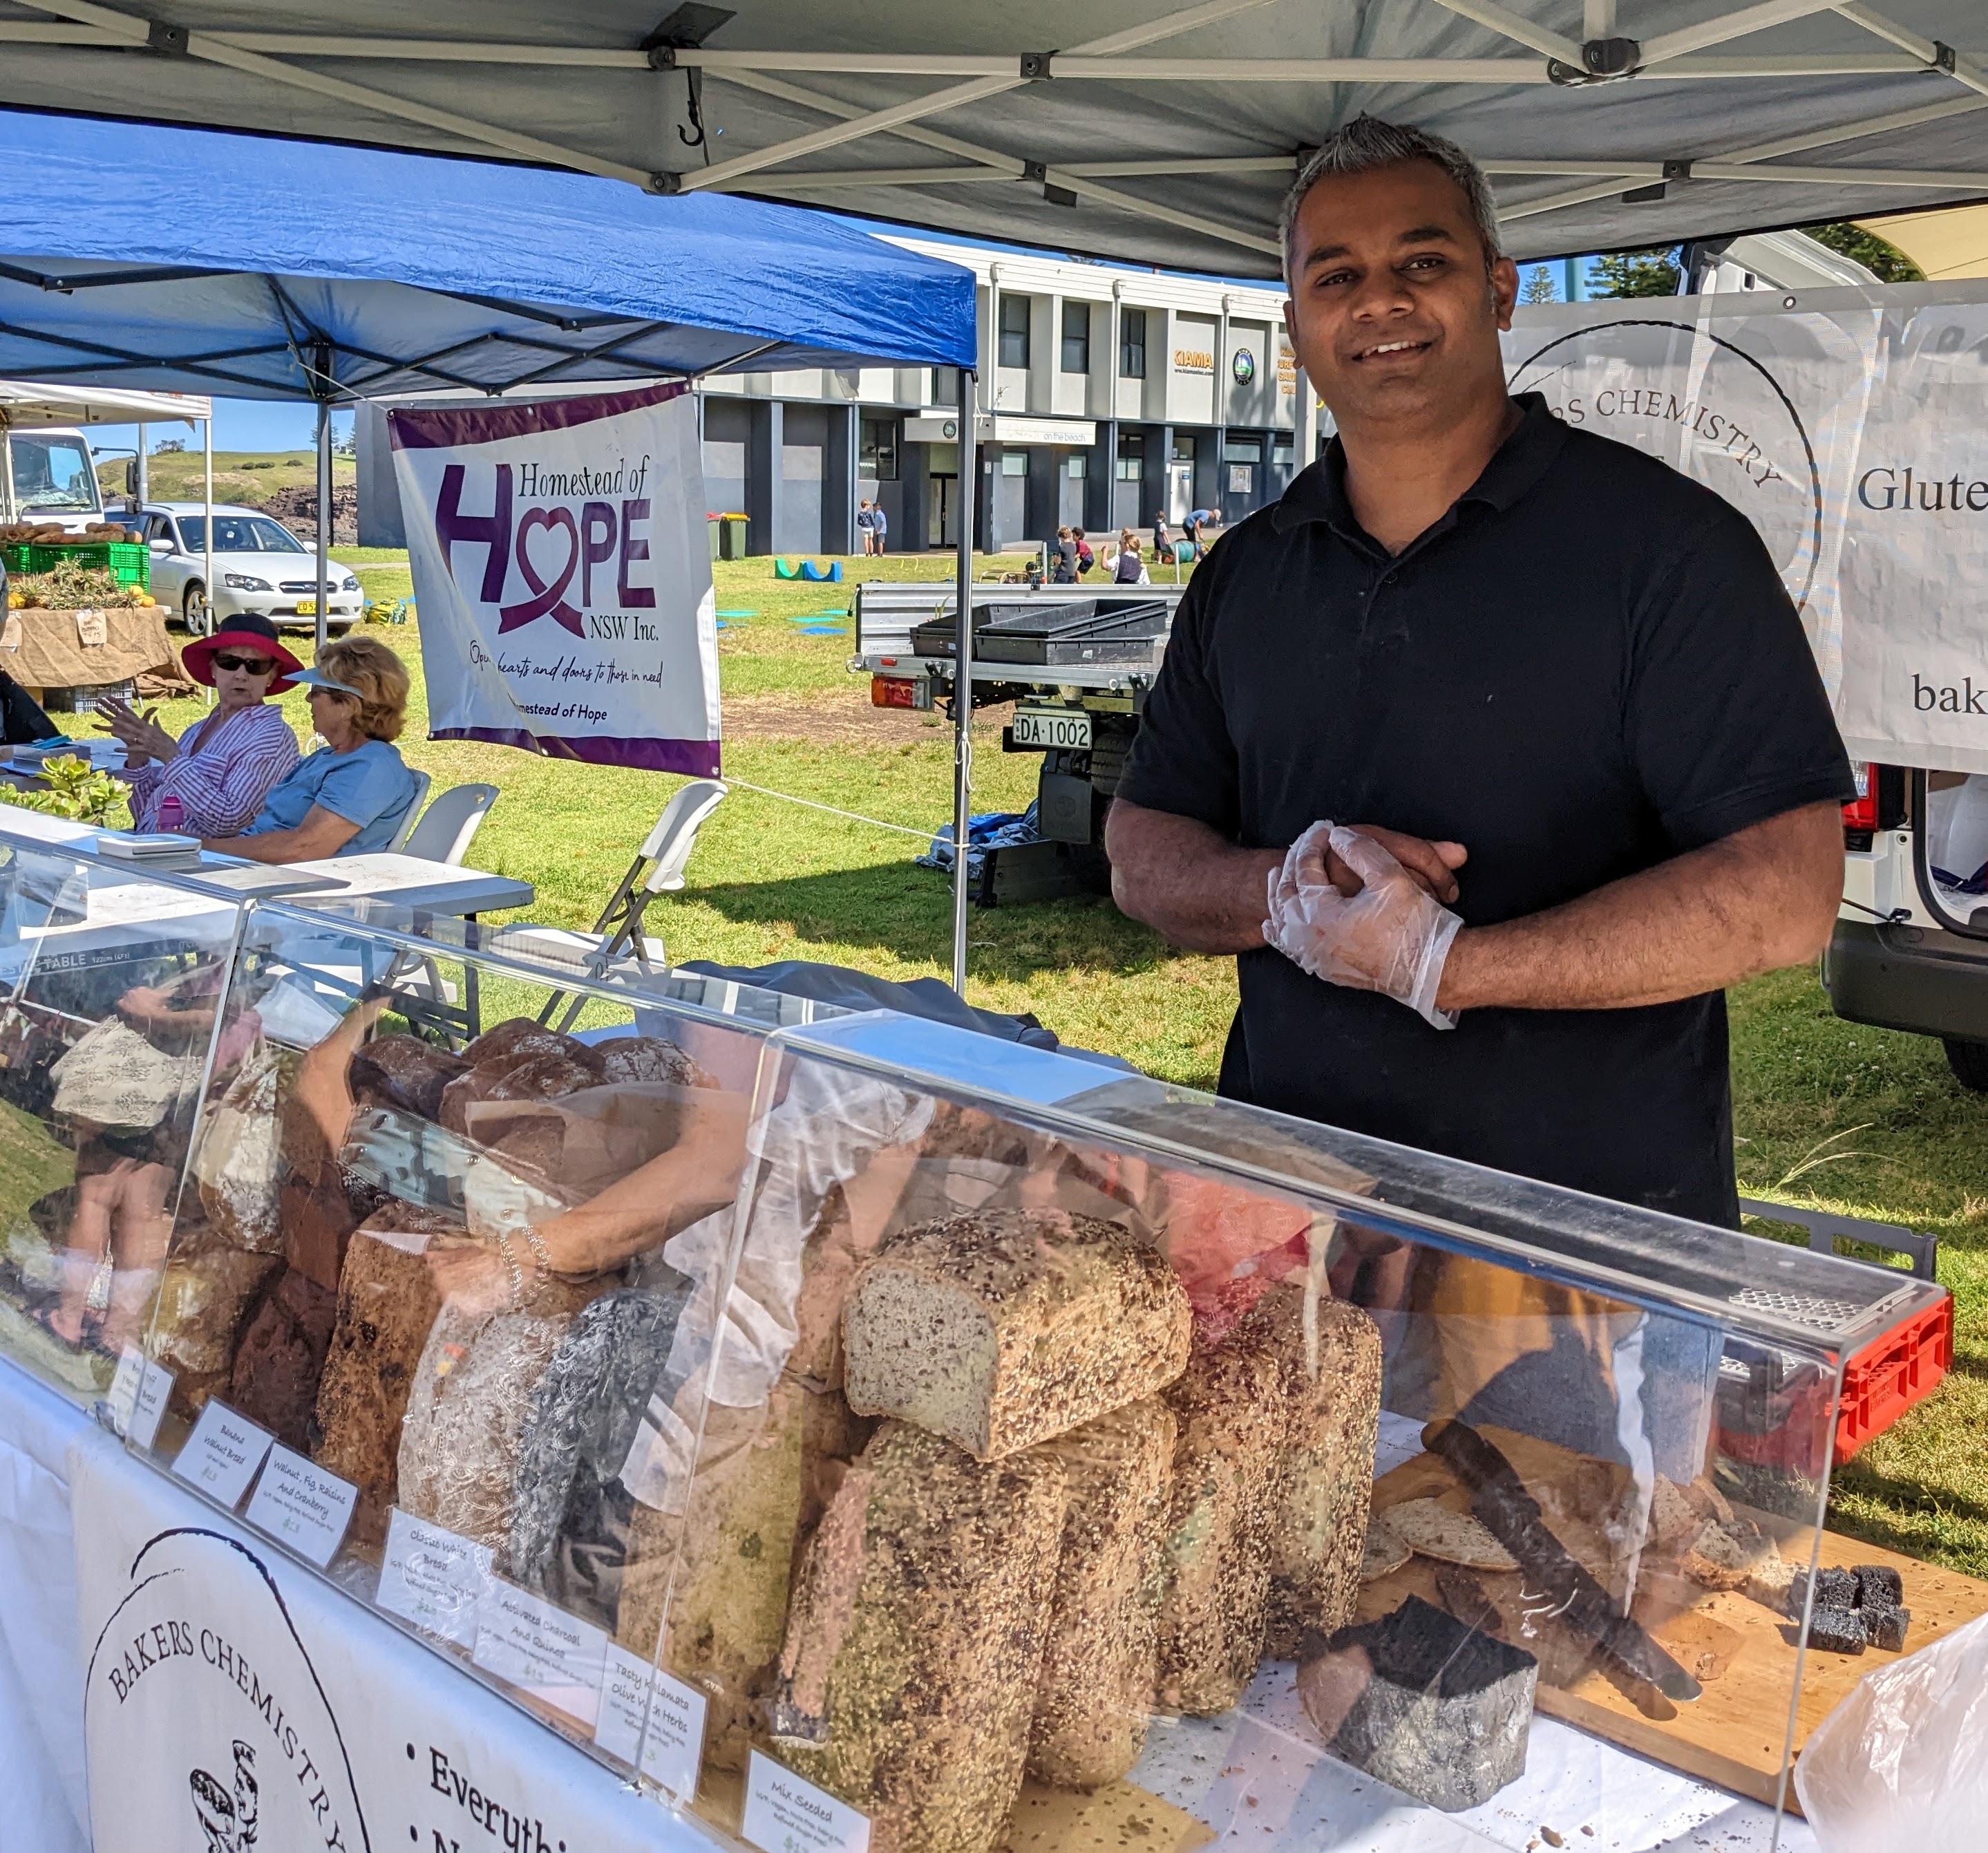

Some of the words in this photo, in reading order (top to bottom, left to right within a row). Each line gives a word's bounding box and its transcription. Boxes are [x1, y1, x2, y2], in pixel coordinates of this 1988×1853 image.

[1174, 350, 1213, 369] KIAMA
[1064, 433, 1086, 442] beach
[1596, 390, 1783, 488] CHEMISTRY
[518, 458, 625, 497] Homestead
[629, 454, 650, 500] of
[435, 464, 656, 639] HOPE
[590, 615, 629, 640] NSW
[634, 616, 659, 641] Inc.
[498, 652, 531, 678] hearts
[533, 656, 565, 681] and
[562, 656, 593, 682] doors
[594, 661, 605, 683] to
[607, 658, 629, 684] those
[632, 668, 640, 681] in
[643, 661, 663, 688] need
[515, 702, 561, 716] mestead
[562, 703, 577, 717] of
[578, 704, 607, 725] Hope
[44, 954, 86, 970] TABLE
[204, 1435, 228, 1455] Walnut
[227, 1448, 247, 1465] Bread
[220, 1424, 245, 1444] Banana
[277, 1483, 296, 1496] And
[294, 1490, 329, 1521] Cranberry
[319, 1483, 346, 1505] Raisins
[410, 1529, 441, 1548] Classic
[442, 1542, 467, 1560] White
[423, 1553, 448, 1571] Bread
[501, 1600, 541, 1626] Activated
[543, 1621, 581, 1646] Charcoal
[511, 1626, 531, 1642] And
[532, 1636, 565, 1659] Quinoa
[108, 1620, 194, 1704] BAKERS
[616, 1662, 642, 1691] Tasty
[645, 1678, 689, 1711] Klamata
[612, 1683, 636, 1704] Olive
[638, 1695, 661, 1718] Wth
[663, 1709, 688, 1733] Herbs
[201, 1628, 346, 1853] CHEMISTRY
[429, 1744, 566, 1853] Everyth
[771, 1780, 793, 1802] Mix
[794, 1795, 833, 1824] Seeded
